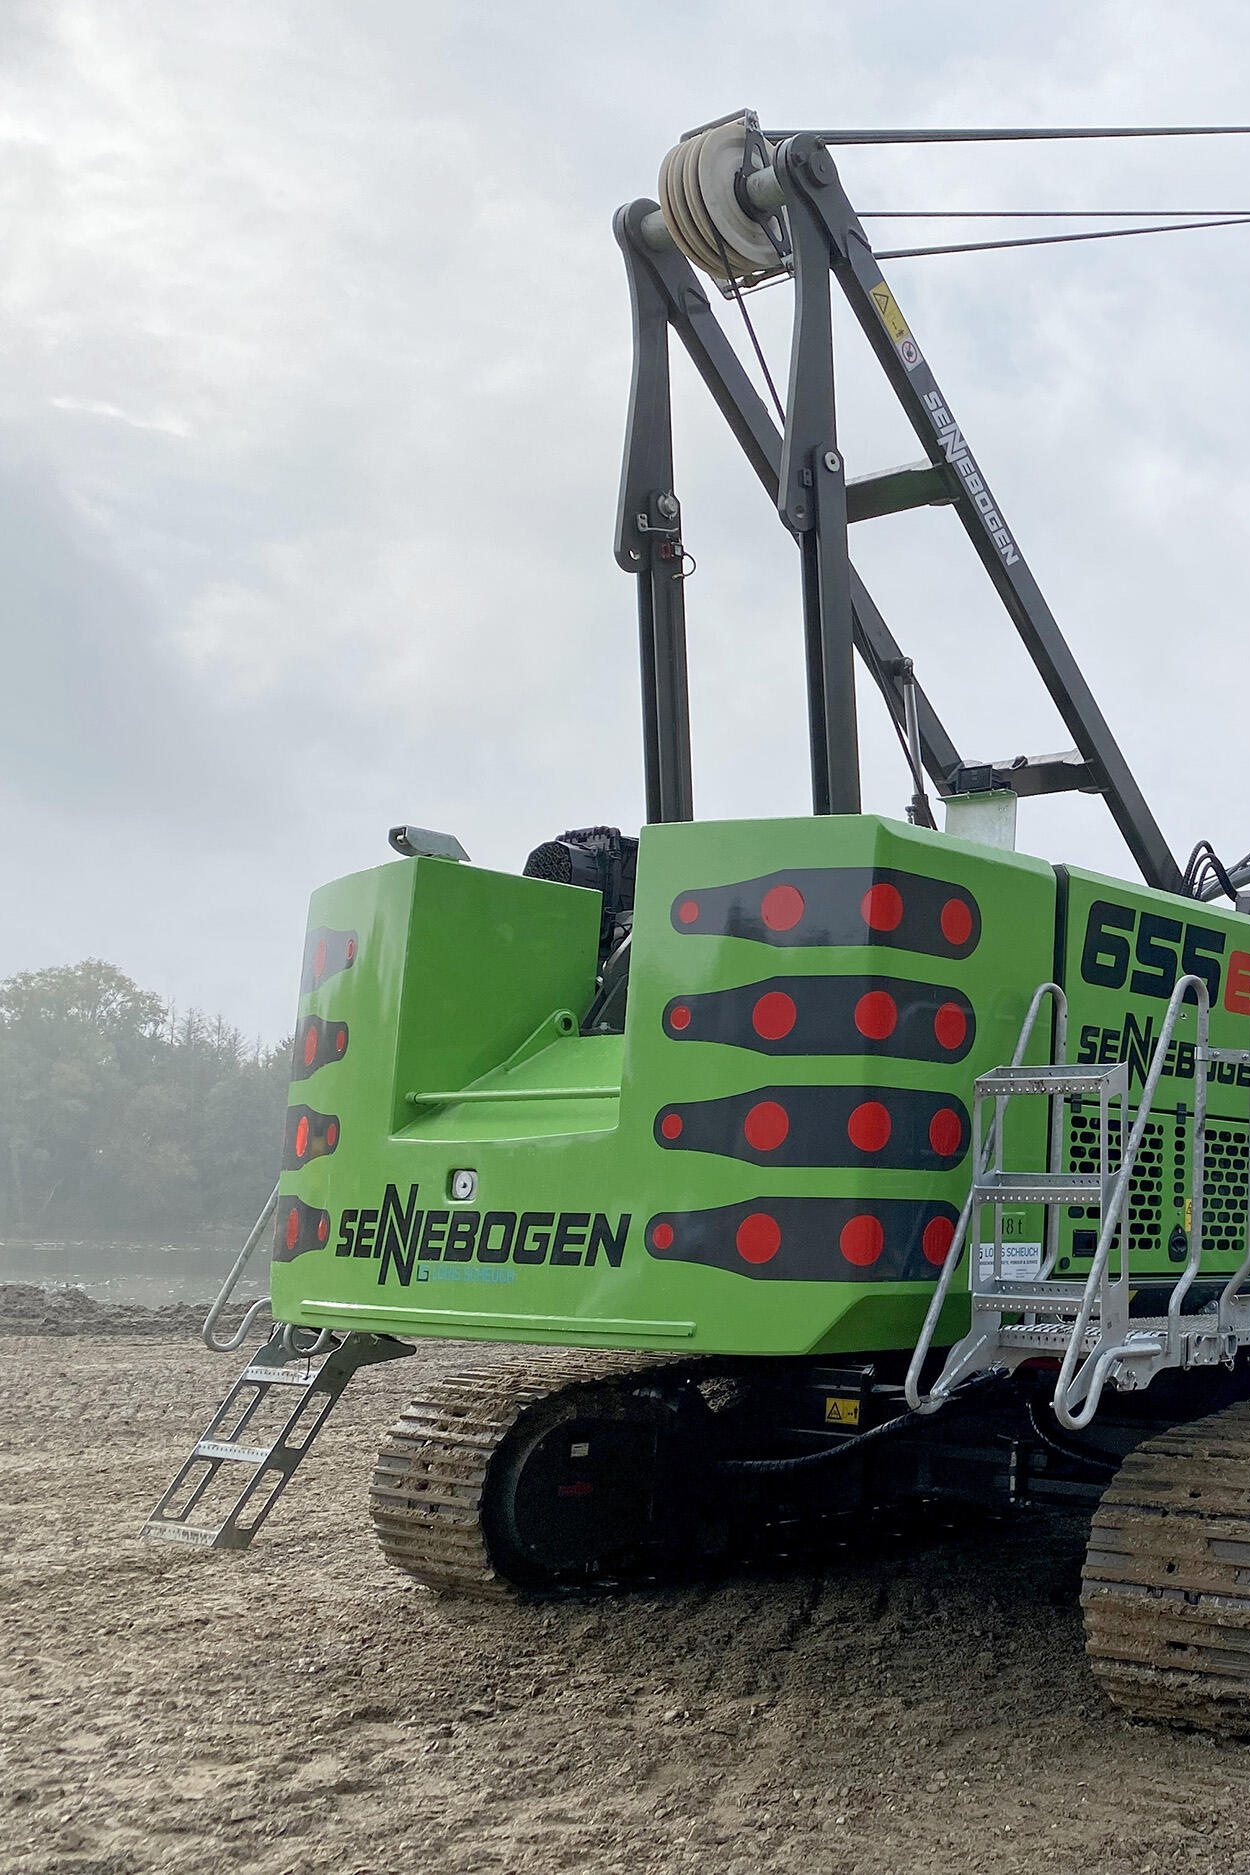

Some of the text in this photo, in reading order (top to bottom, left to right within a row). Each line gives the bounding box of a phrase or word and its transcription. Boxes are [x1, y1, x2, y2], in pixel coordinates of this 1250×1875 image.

[922, 390, 1020, 567] SENNEBOGEN
[335, 1183, 632, 1287] SENNEBOGEN
[984, 1246, 1039, 1258] LOS SCHEUCH
